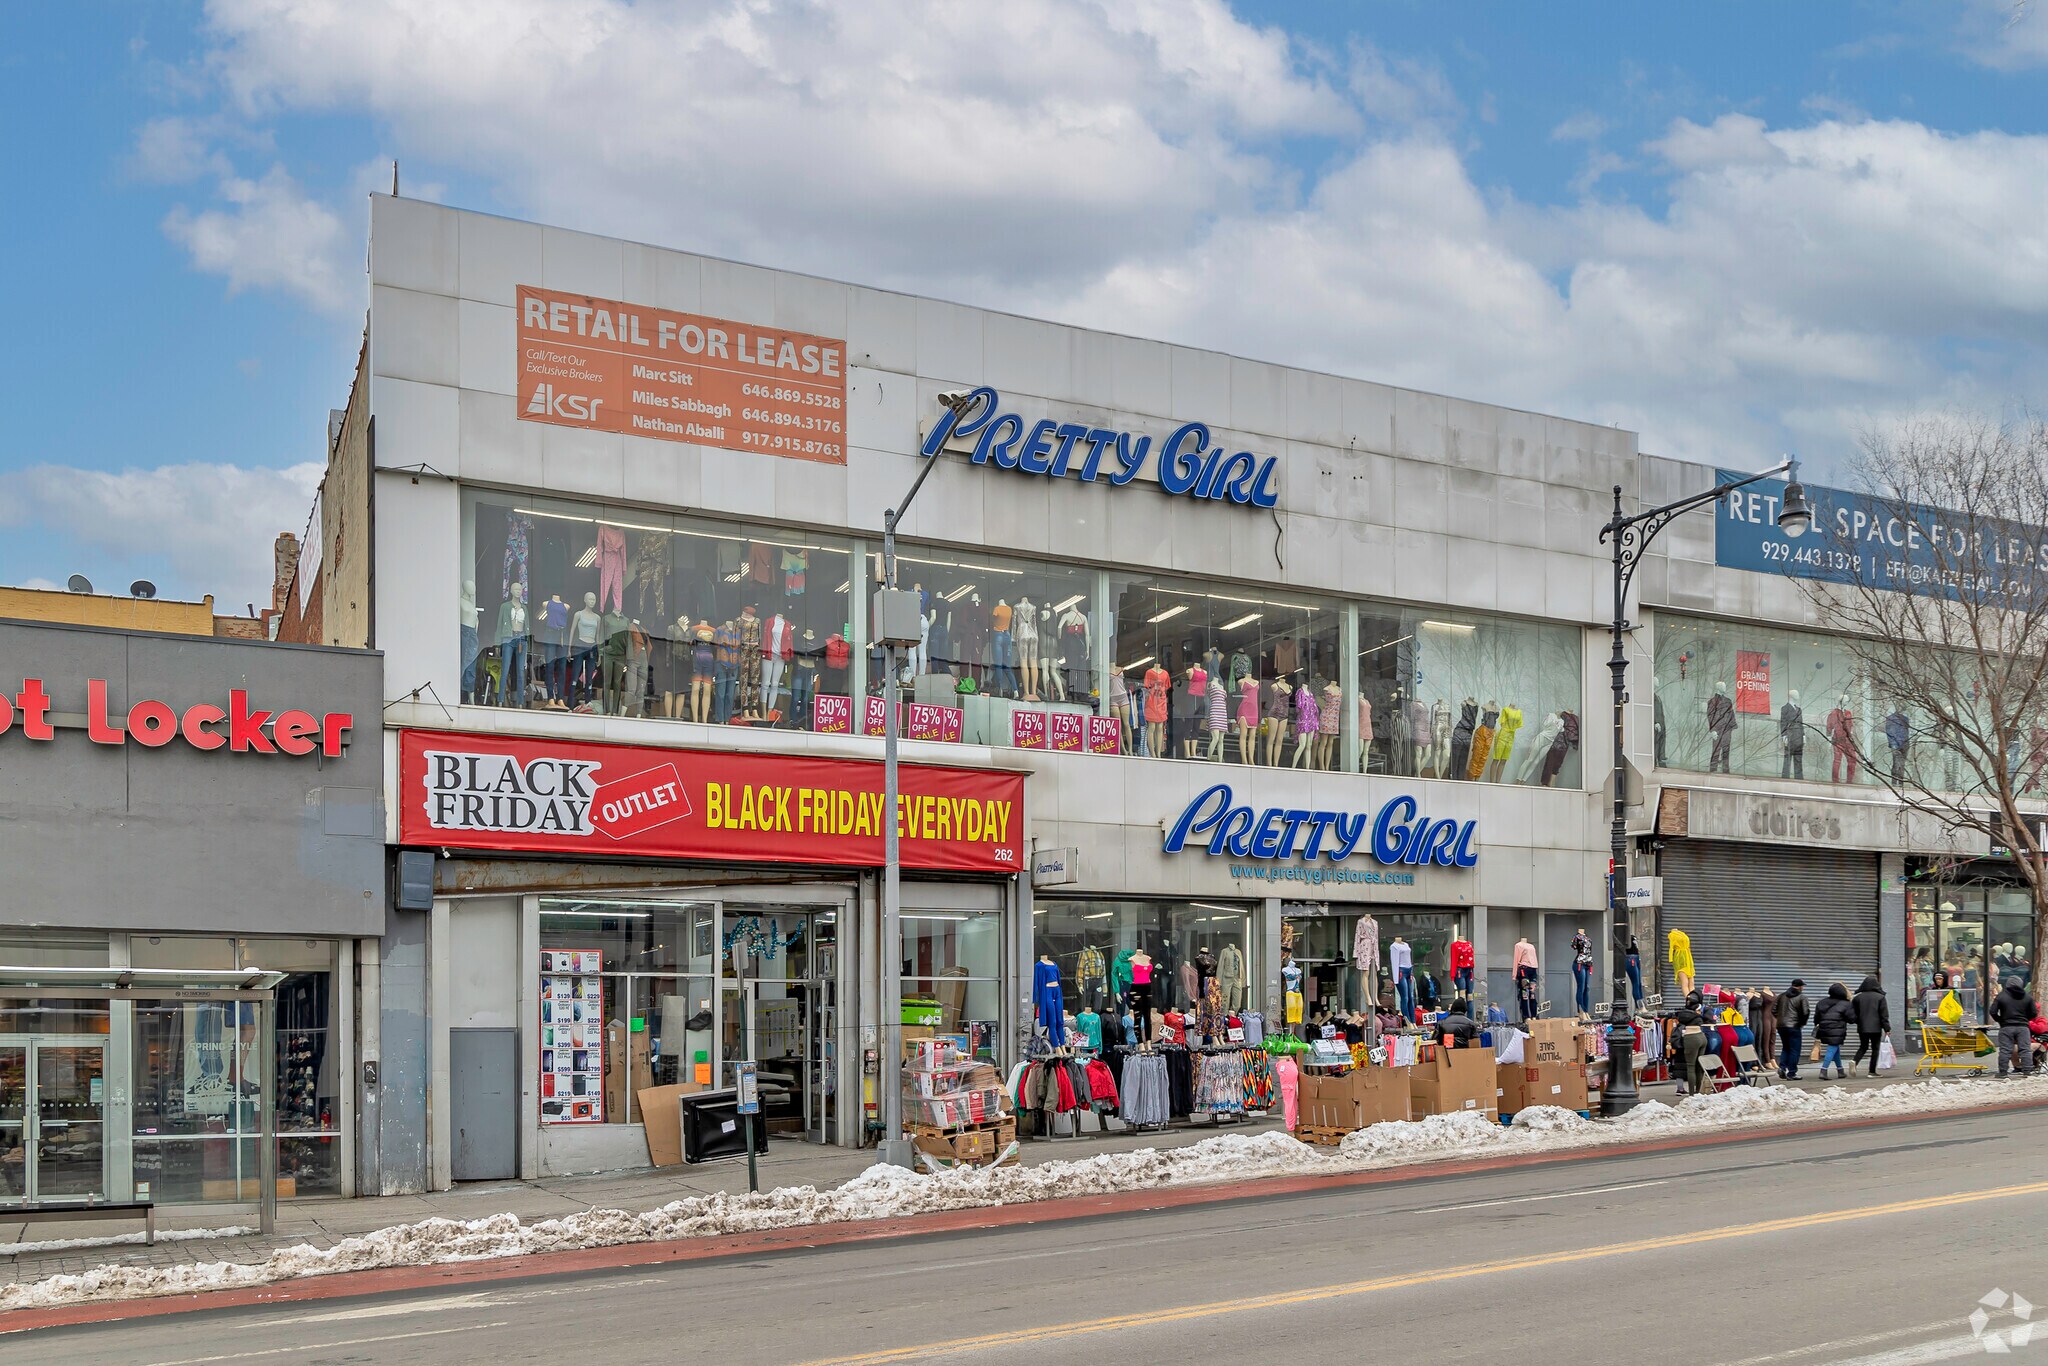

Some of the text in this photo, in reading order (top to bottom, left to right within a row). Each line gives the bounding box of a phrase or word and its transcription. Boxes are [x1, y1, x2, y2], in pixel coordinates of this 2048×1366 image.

[524, 297, 840, 378] RETAIL FOR LEASE
[526, 348, 586, 367] Call/Text Our
[526, 362, 603, 383] Exclusive Brokers
[632, 365, 841, 409] Marc Sitt 646.869.5528
[632, 391, 841, 433] Miles Sabbagh 646.894.3176
[632, 415, 841, 457] Nathan Aballi 917.915.8763
[1159, 421, 1279, 508] GIRL
[1730, 489, 1822, 533] RETL
[1836, 508, 1920, 550] SPACE
[1931, 524, 1984, 560] FOR
[1762, 541, 1861, 573] 929.443.1378
[1741, 670, 1767, 681] GRAND
[1737, 680, 1770, 692] OPENING
[819, 698, 847, 717] 50%
[914, 706, 940, 725] 75%
[0, 678, 353, 758] t Locker
[821, 720, 846, 733] SALE
[867, 717, 883, 726] OFF
[1017, 713, 1043, 731] 75%
[1055, 715, 1080, 733] 75%
[912, 724, 928, 732] OFF
[1016, 730, 1031, 738] OFF
[1054, 732, 1069, 740] OFF
[1092, 719, 1117, 736] 50%
[1020, 734, 1042, 748] SALE
[1057, 736, 1079, 750] SALE
[1091, 735, 1106, 743] OFF
[1094, 740, 1115, 753] SALE
[433, 755, 591, 798] BLACK
[602, 781, 678, 823] OUTLET
[433, 792, 591, 832] FRIDAY
[706, 782, 1012, 843] BLACK FRIDAY EVERYDAY
[1162, 783, 1478, 868] PRETTY GIRL
[994, 848, 1013, 862] 262
[1229, 864, 1415, 887] www.prettygirlstores.com
[1538, 1002, 1550, 1012] 3.99
[1596, 1004, 1609, 1012] 3.99
[1647, 996, 1661, 1005] 3.99
[1423, 1014, 1436, 1022] 5.99
[1166, 1028, 1174, 1037] $10
[190, 1042, 225, 1051] SPRING
[1376, 1048, 1387, 1056] $10
[1539, 1042, 1556, 1051] SALE
